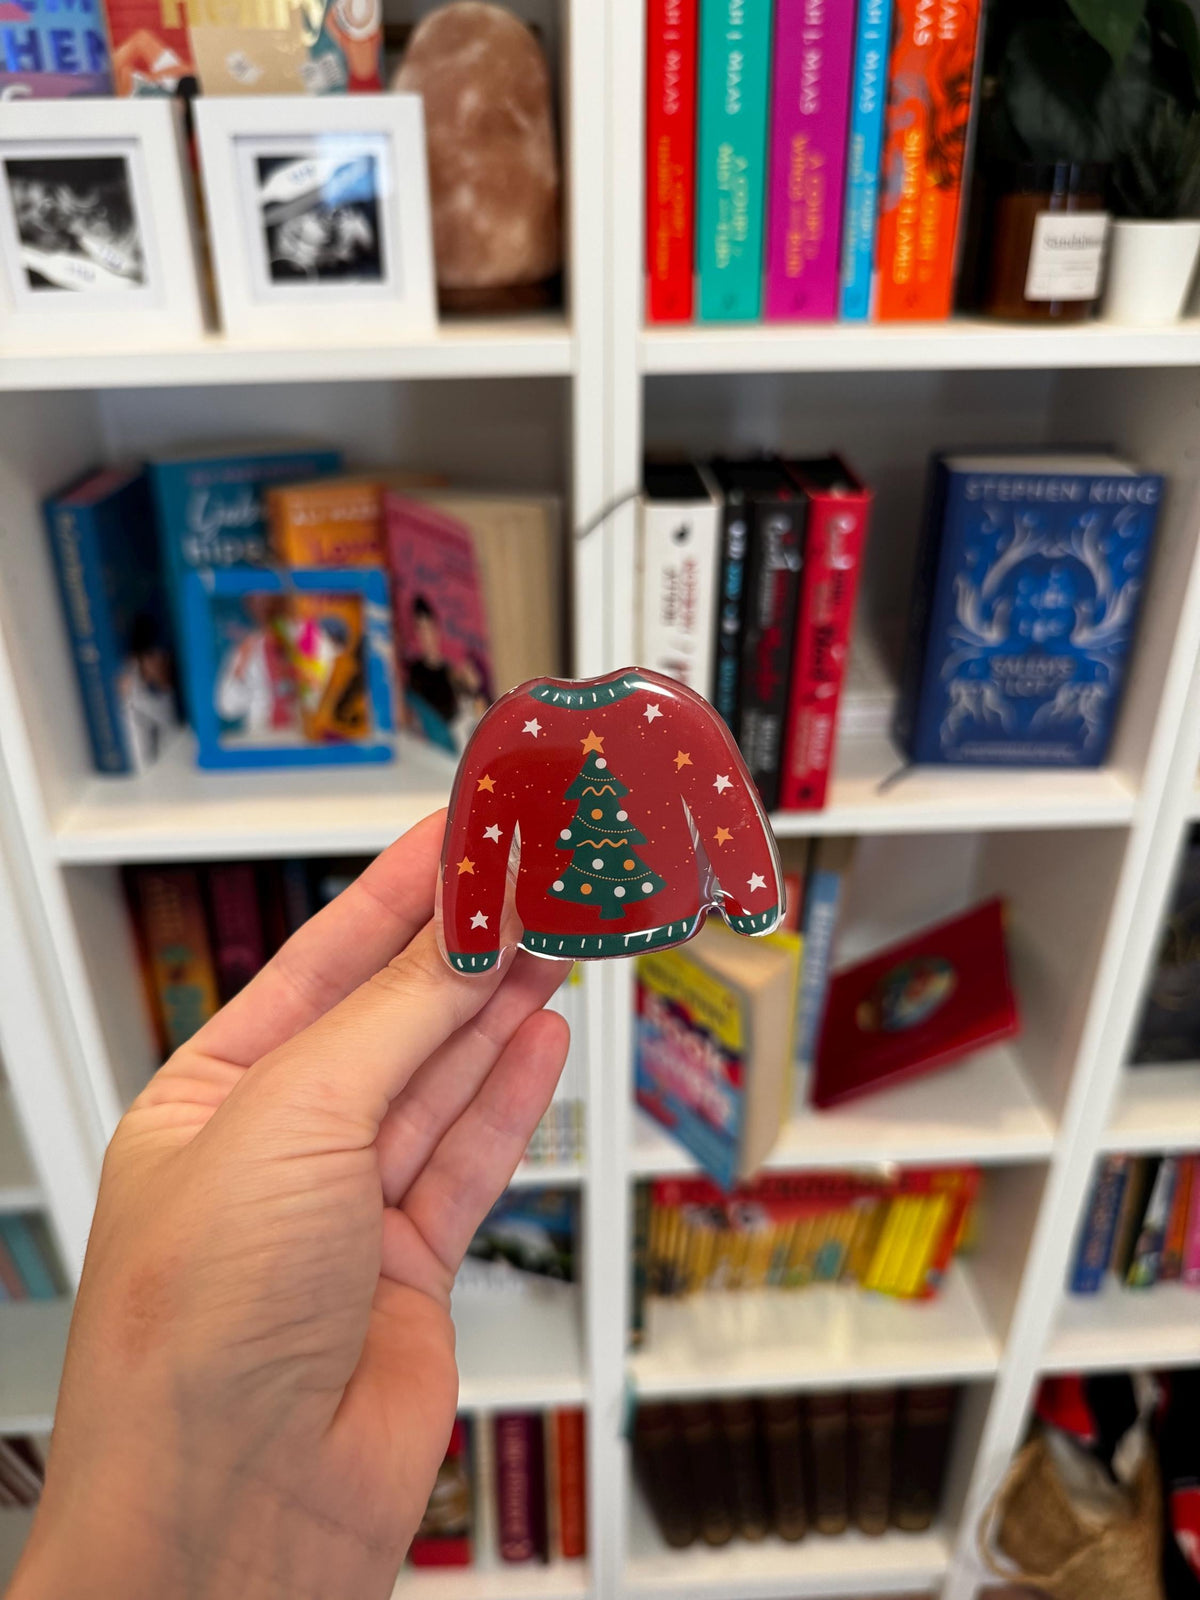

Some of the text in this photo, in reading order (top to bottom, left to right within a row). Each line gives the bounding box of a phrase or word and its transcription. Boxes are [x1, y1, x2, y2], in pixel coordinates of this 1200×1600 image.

[663, 50, 681, 115] MAAS
[725, 50, 744, 115] MAAS
[800, 50, 822, 115] MAAS
[859, 51, 880, 113] MAAS
[965, 477, 1159, 504] STEPHEN KING
